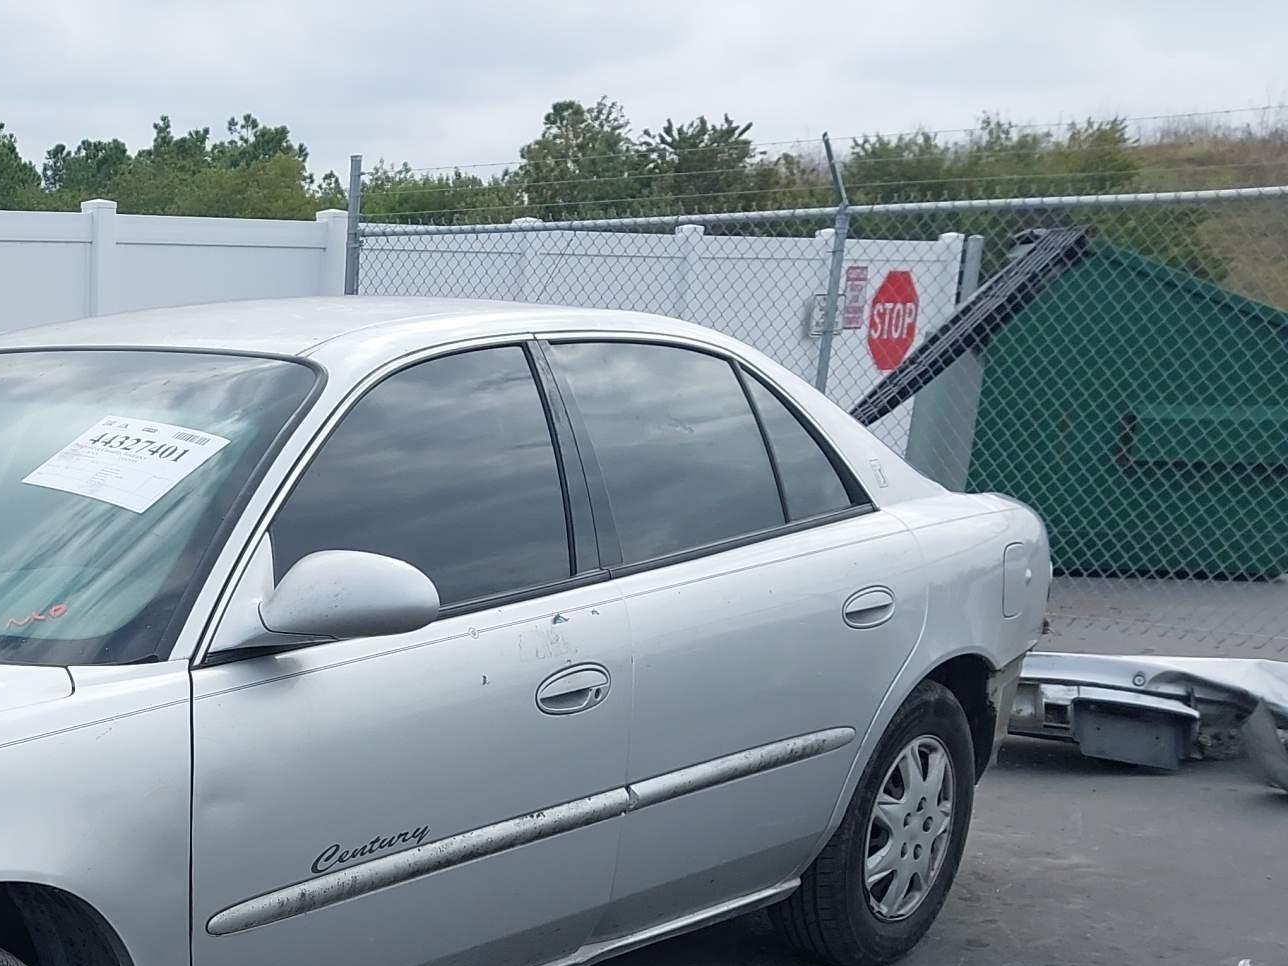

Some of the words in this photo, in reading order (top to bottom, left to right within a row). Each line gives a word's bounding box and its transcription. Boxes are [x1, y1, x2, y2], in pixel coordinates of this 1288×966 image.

[870, 302, 916, 339] STOP
[88, 432, 191, 463] 44327401
[310, 825, 431, 874] Century
